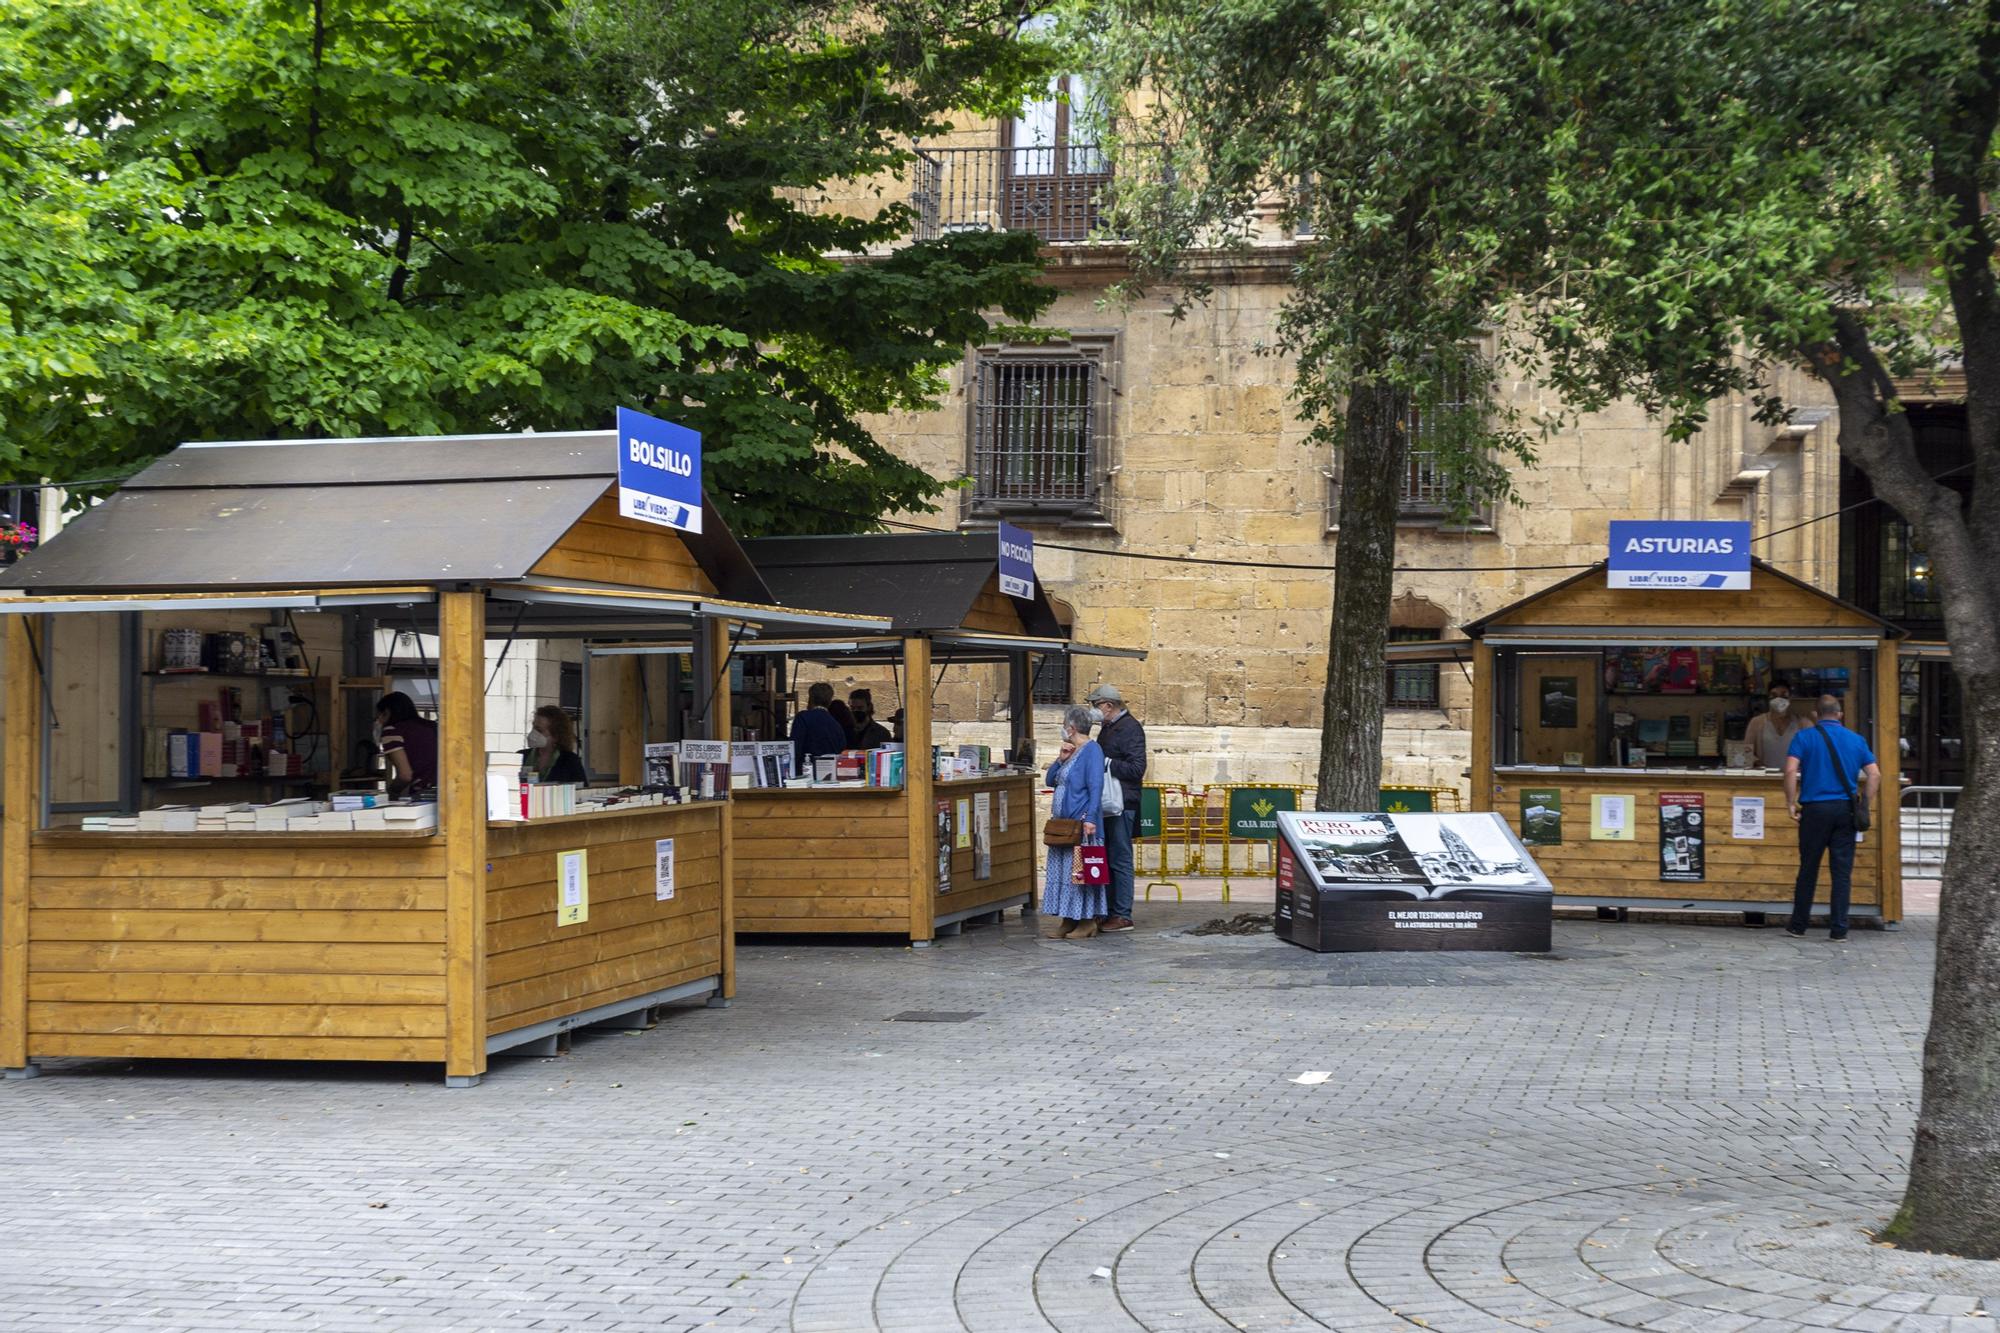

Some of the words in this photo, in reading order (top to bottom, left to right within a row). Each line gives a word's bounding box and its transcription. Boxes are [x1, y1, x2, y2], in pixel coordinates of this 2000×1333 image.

[630, 438, 692, 477] BOLSILLO
[1625, 538, 1733, 554] ASTURIAS
[1001, 541, 1010, 557] NO
[1011, 544, 1032, 564] FICCIÓN
[686, 743, 703, 752] ESTOS
[703, 744, 722, 752] LIBROS
[1302, 820, 1351, 829] PURO
[1307, 827, 1386, 835] ASTURIAS
[1388, 911, 1396, 920] EL
[1397, 911, 1418, 920] MEJOR
[1419, 911, 1455, 920] TESTIMONIO
[1456, 910, 1483, 920] GRÁFICO
